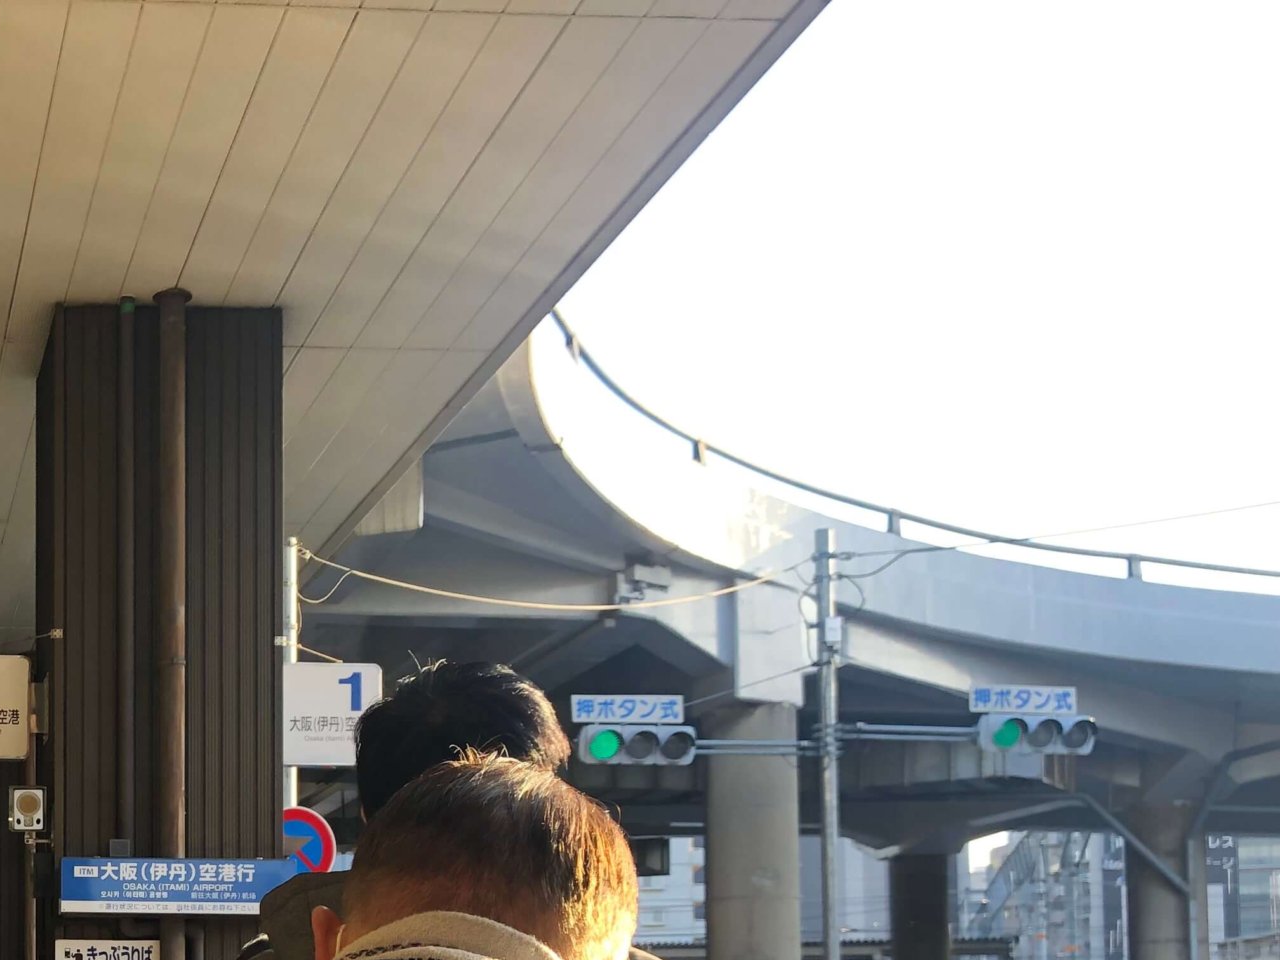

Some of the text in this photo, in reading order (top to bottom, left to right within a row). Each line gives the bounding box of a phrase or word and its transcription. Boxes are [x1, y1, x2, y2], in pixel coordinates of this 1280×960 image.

[338, 672, 362, 711] 1
[974, 688, 1072, 711] 押ボタン式
[576, 699, 679, 719] 押ボタン式
[289, 716, 359, 733] 大阪(伊丹)空
[77, 862, 256, 882] ITM 大阪（伊丹）空港行
[123, 883, 234, 892] OSAKA (ITAMI) AIRPORT
